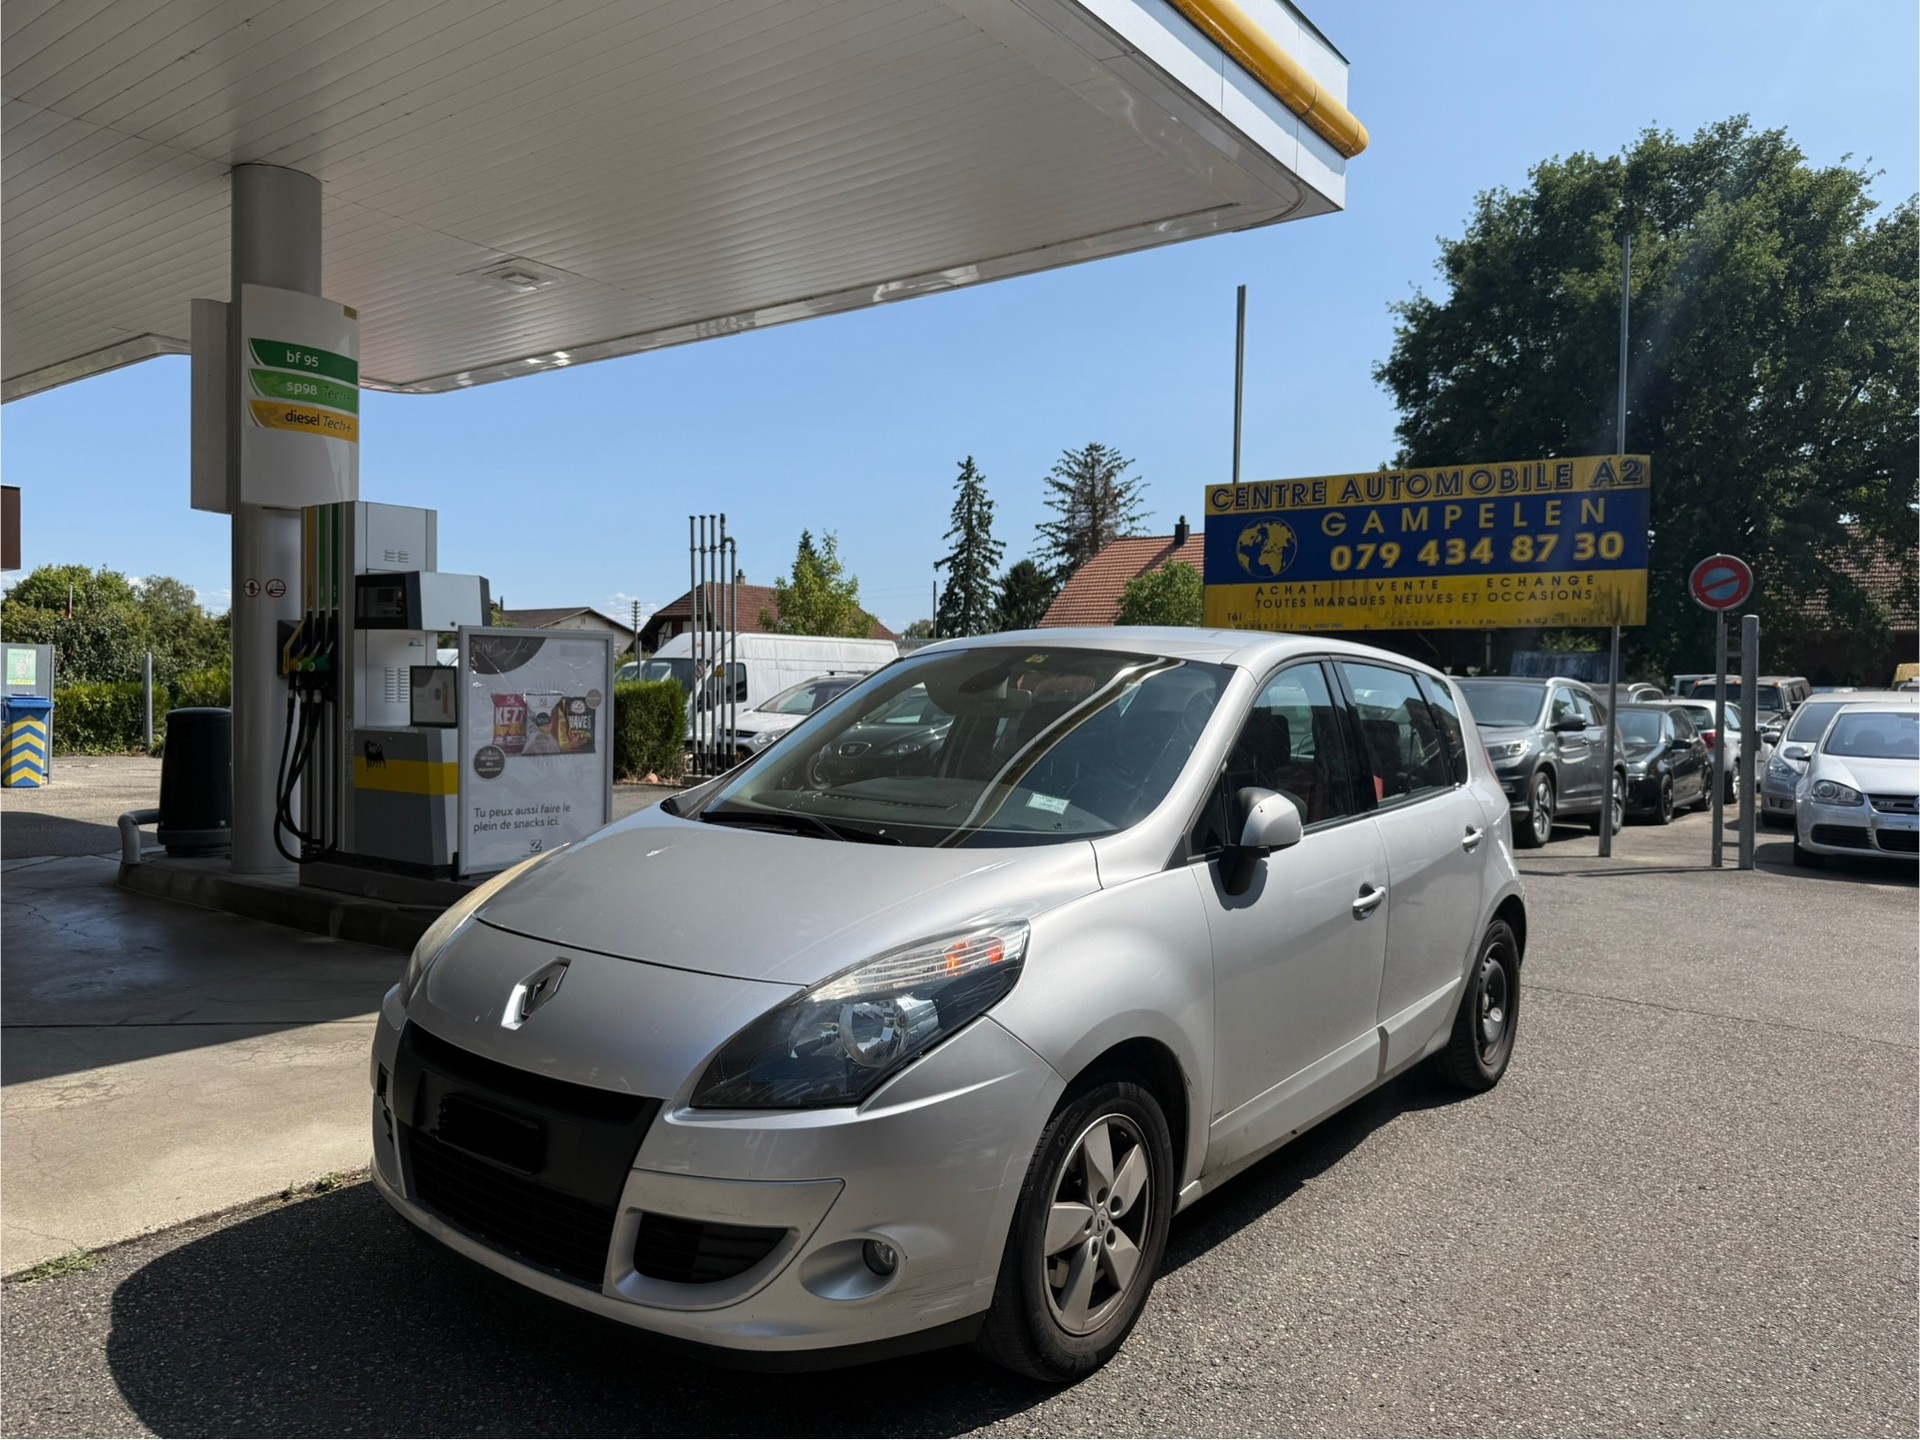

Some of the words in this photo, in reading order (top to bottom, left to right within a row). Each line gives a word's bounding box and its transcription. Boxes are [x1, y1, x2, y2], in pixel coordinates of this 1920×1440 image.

[286, 350, 301, 364] bf
[304, 354, 319, 367] 95
[286, 381, 318, 396] sp98
[285, 409, 320, 427] diesel
[323, 415, 352, 433] Tech+
[1210, 479, 1327, 511] CENTRE
[1338, 461, 1573, 502] AUTOMOBILE
[1590, 457, 1646, 488] A2
[1321, 497, 1605, 537] GAMPELEN
[1330, 541, 1402, 572] 079
[1417, 537, 1494, 567] 434
[1509, 533, 1560, 562] 87
[1573, 531, 1626, 561] 30
[1256, 583, 1318, 595] ACHAT
[1375, 579, 1440, 593] VENTE
[1486, 574, 1596, 588] ECHANGE
[1256, 596, 1307, 609] TOUTES
[1313, 592, 1389, 607] MARQUES
[1393, 591, 1454, 605] NEUVES
[1461, 590, 1479, 603] ET
[1486, 588, 1594, 602] OCCASIONS
[473, 807, 486, 818] Tu
[489, 808, 513, 820] peux
[515, 806, 538, 816] aussi
[540, 803, 560, 814] faire
[562, 802, 570, 813] le
[473, 820, 497, 834] plein
[500, 819, 511, 830] de
[513, 817, 545, 829] snacks
[547, 815, 560, 826] ici.
